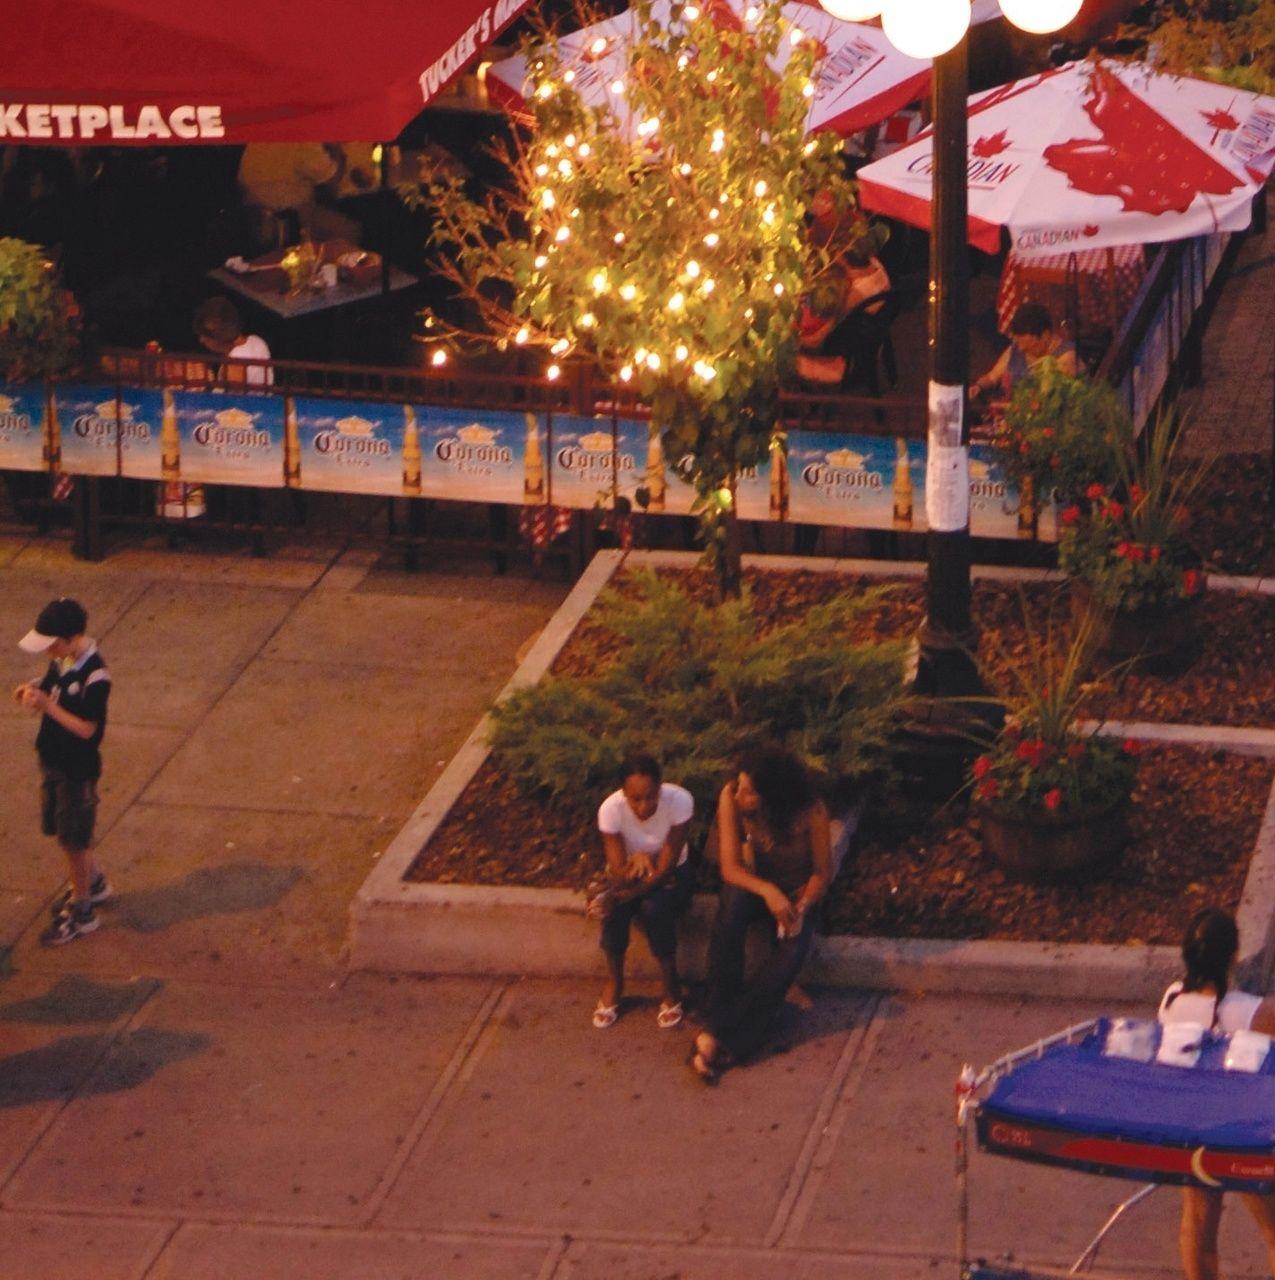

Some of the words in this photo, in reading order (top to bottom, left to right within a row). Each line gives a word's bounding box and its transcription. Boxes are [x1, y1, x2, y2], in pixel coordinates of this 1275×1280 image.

[419, 7, 492, 103] TUCKER'S
[0, 103, 226, 139] KETPLACE
[907, 152, 1021, 184] CDIAN
[73, 414, 151, 440] Corona
[192, 422, 273, 449] Corona
[313, 433, 392, 458] Corona
[434, 439, 513, 466] Corona
[556, 448, 636, 474] Corona
[802, 462, 883, 492] Corona
[968, 479, 1007, 499] ona
